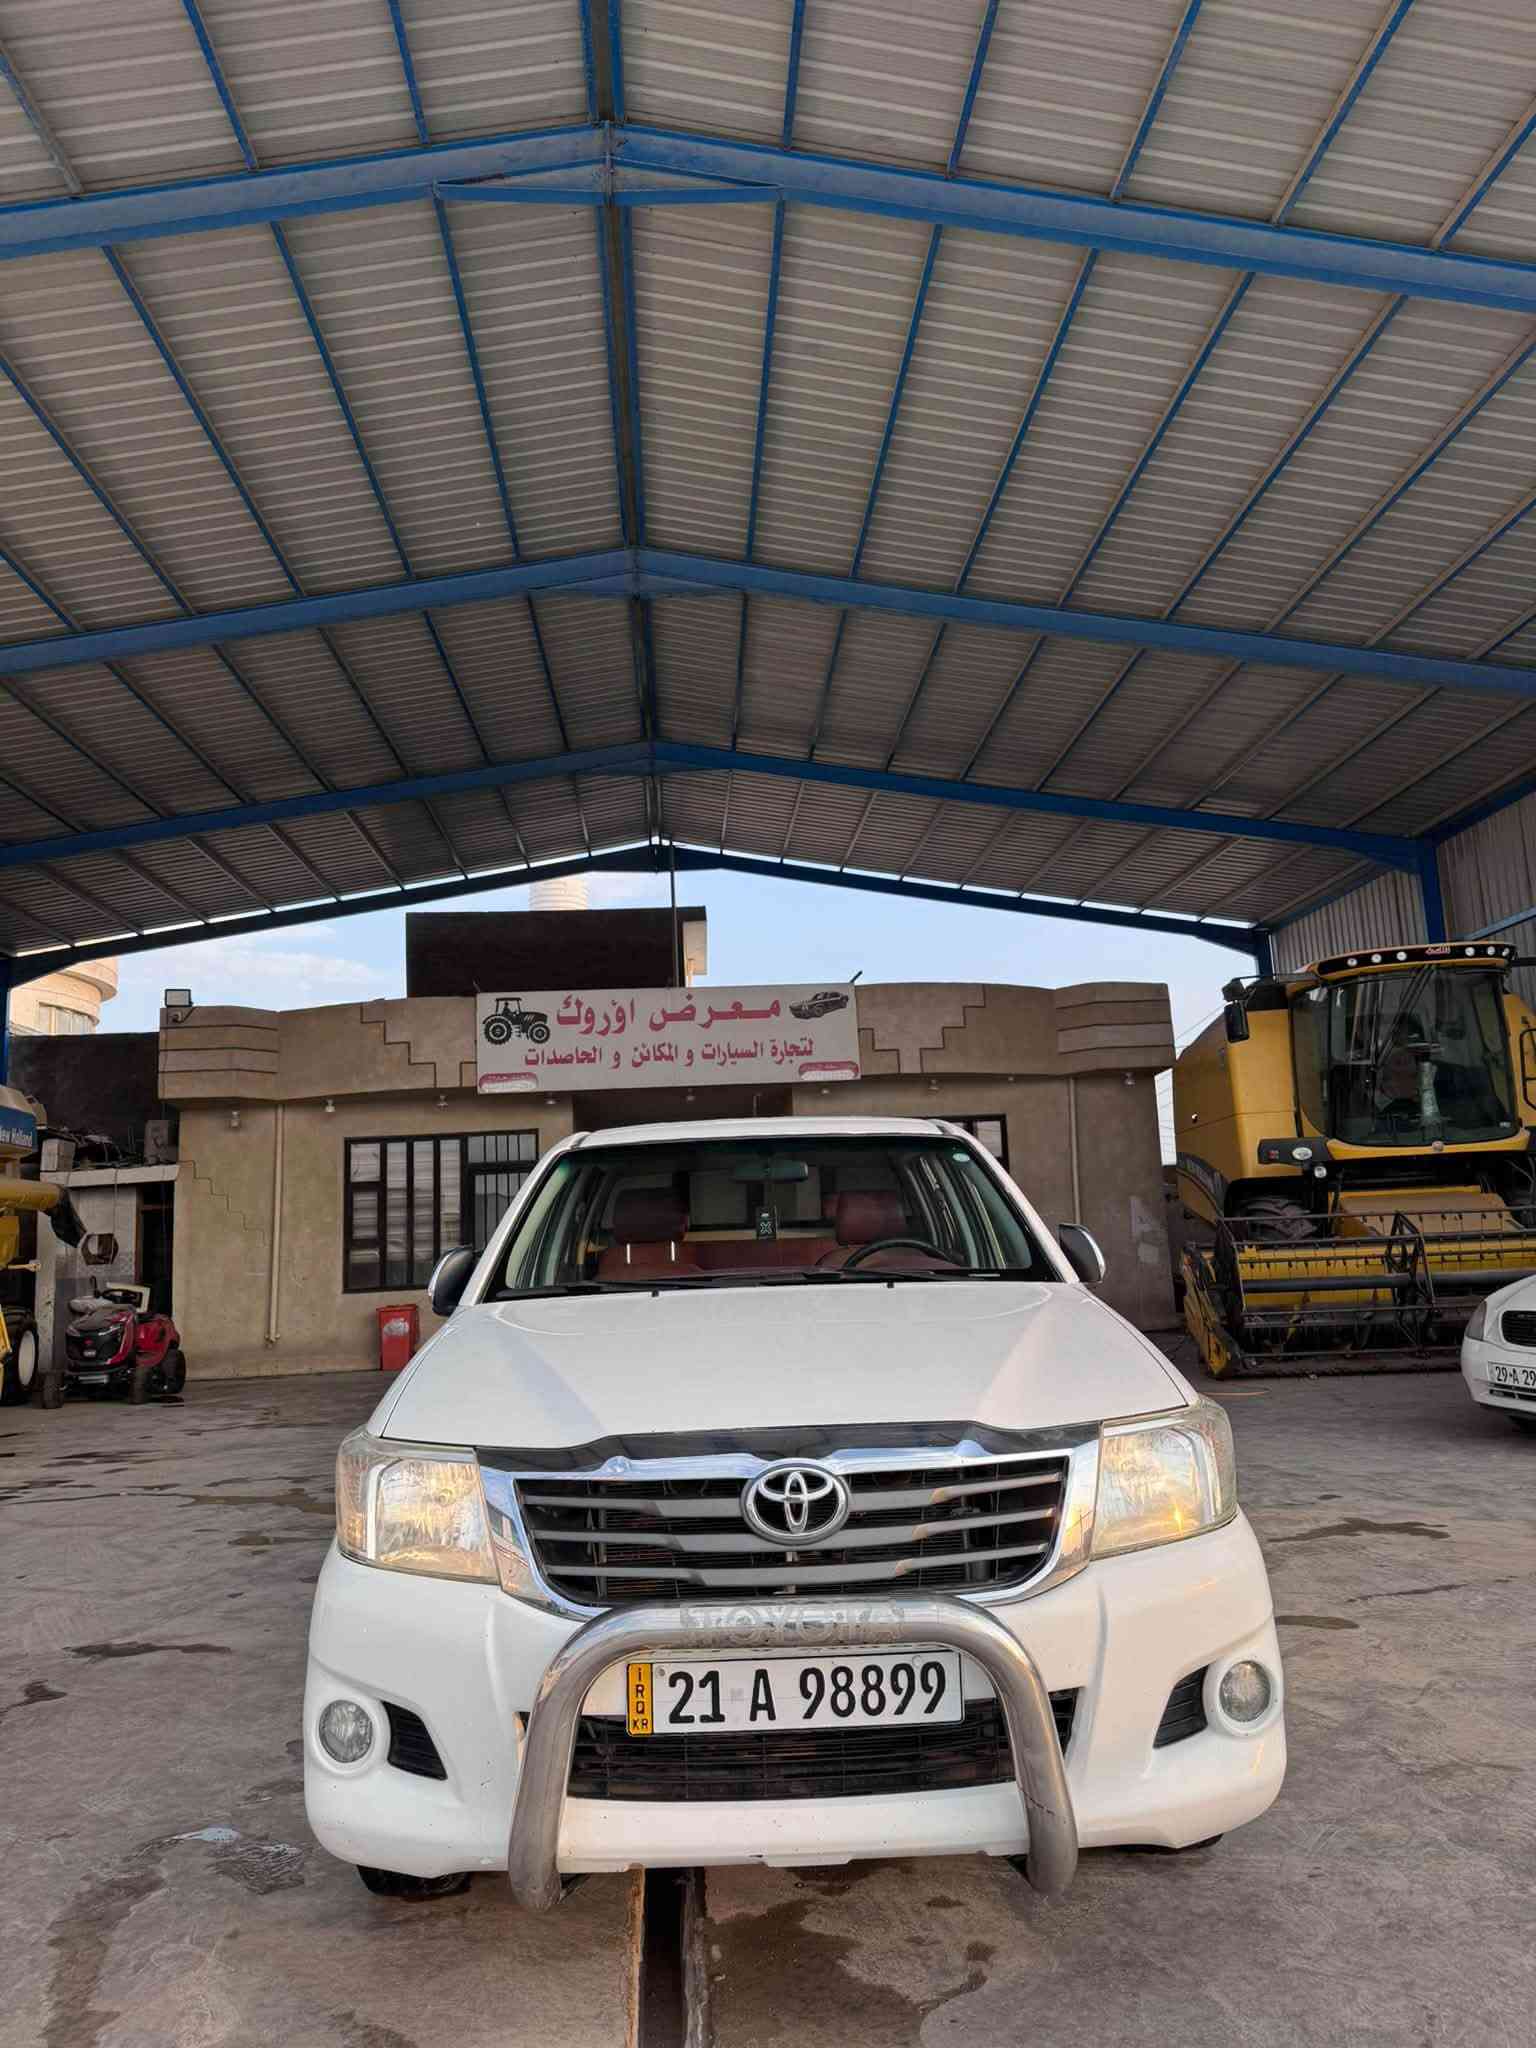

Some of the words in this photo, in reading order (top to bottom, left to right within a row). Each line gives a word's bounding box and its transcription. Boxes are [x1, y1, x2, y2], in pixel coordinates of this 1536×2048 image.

[611, 1049, 621, 1069] و
[684, 1047, 694, 1067] و
[702, 1039, 763, 1066] السيارات
[682, 1603, 904, 1645] TOYOTA
[668, 1670, 726, 1724] 21
[749, 1668, 777, 1721] A
[799, 1661, 946, 1720] 98899
